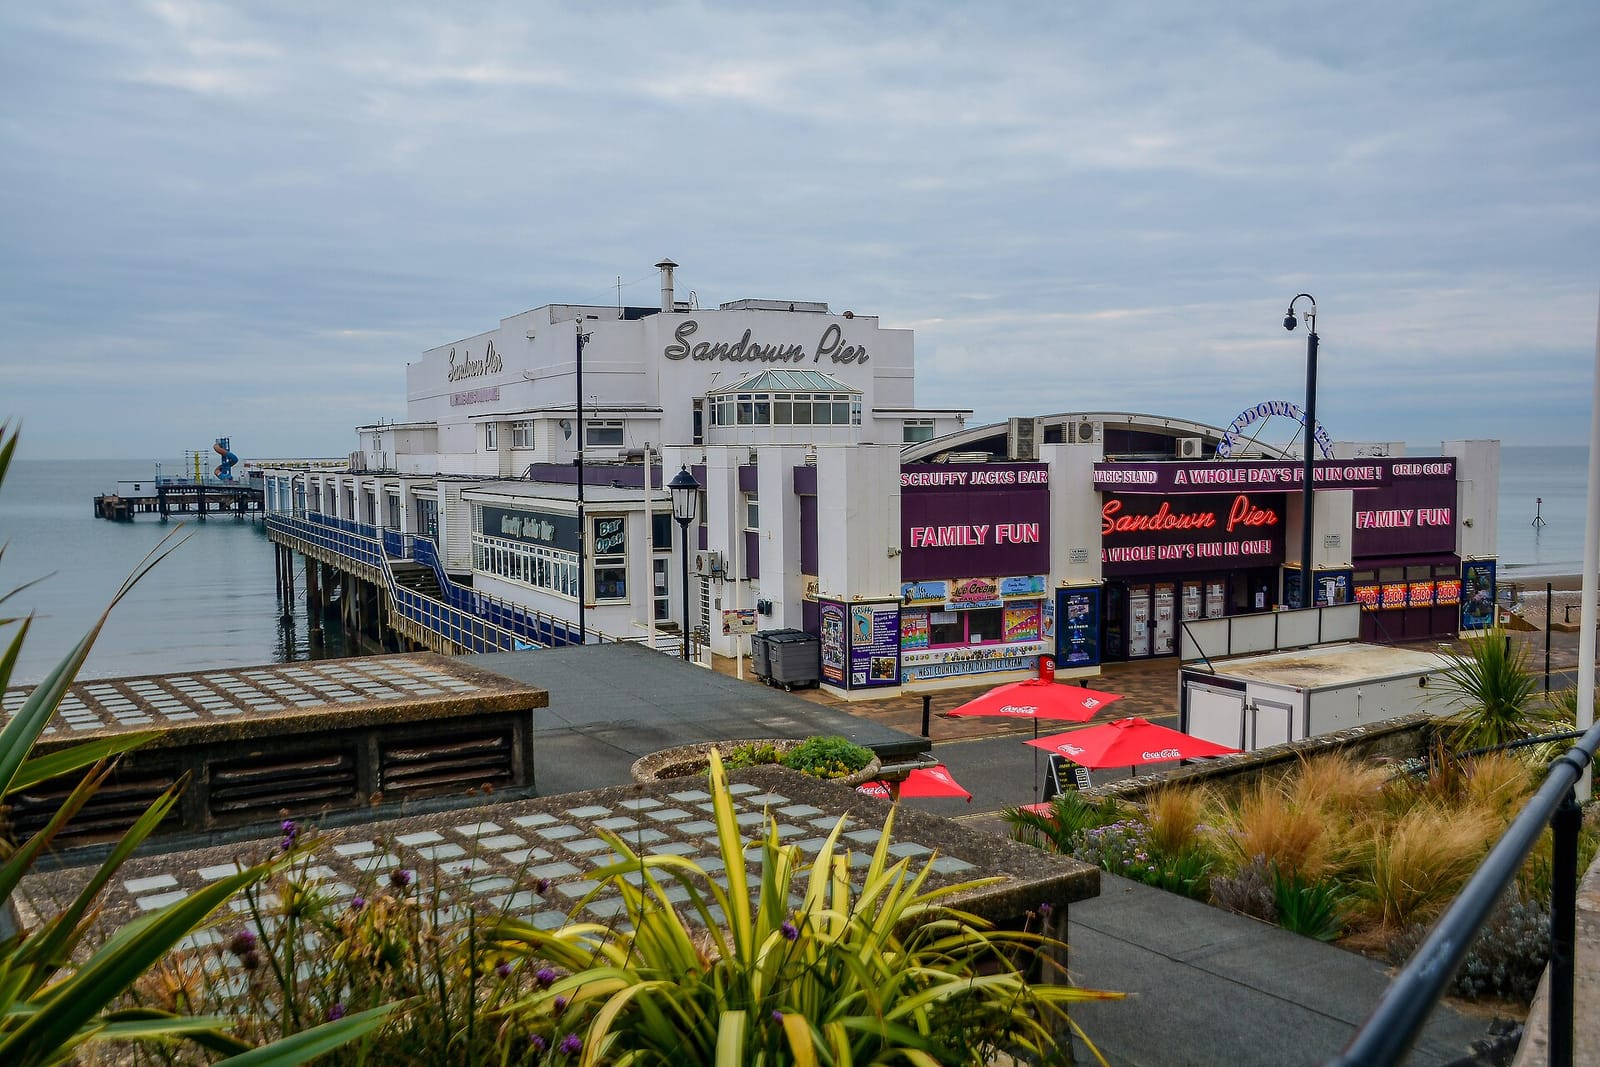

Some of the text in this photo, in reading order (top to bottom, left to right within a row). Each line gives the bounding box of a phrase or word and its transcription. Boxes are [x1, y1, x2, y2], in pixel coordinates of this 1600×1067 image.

[664, 320, 870, 365] Sandown Pier
[1216, 400, 1298, 458] SANDOWN
[900, 470, 1048, 486] SCRUFFY JACKS BAR
[1093, 470, 1158, 484] MAGIC ISLAND
[1174, 469, 1188, 484] A
[1189, 468, 1247, 484] WHOLE
[1247, 467, 1292, 483] DAY'S
[1325, 466, 1343, 481] IN
[1423, 462, 1452, 475] GOLF
[1101, 495, 1279, 536] Sandown Pier
[1355, 507, 1451, 529] FAMILY FUN
[599, 519, 622, 536] Bar
[910, 522, 1040, 548] FAMILY FUN
[595, 532, 625, 553] Open
[1101, 548, 1109, 563] A
[1108, 546, 1156, 562] WHOLE
[1158, 543, 1194, 560] DAY'S
[1197, 541, 1223, 558] FUN
[1224, 540, 1239, 556] IN
[1241, 539, 1273, 555] ONE!
[969, 583, 997, 595] Cream
